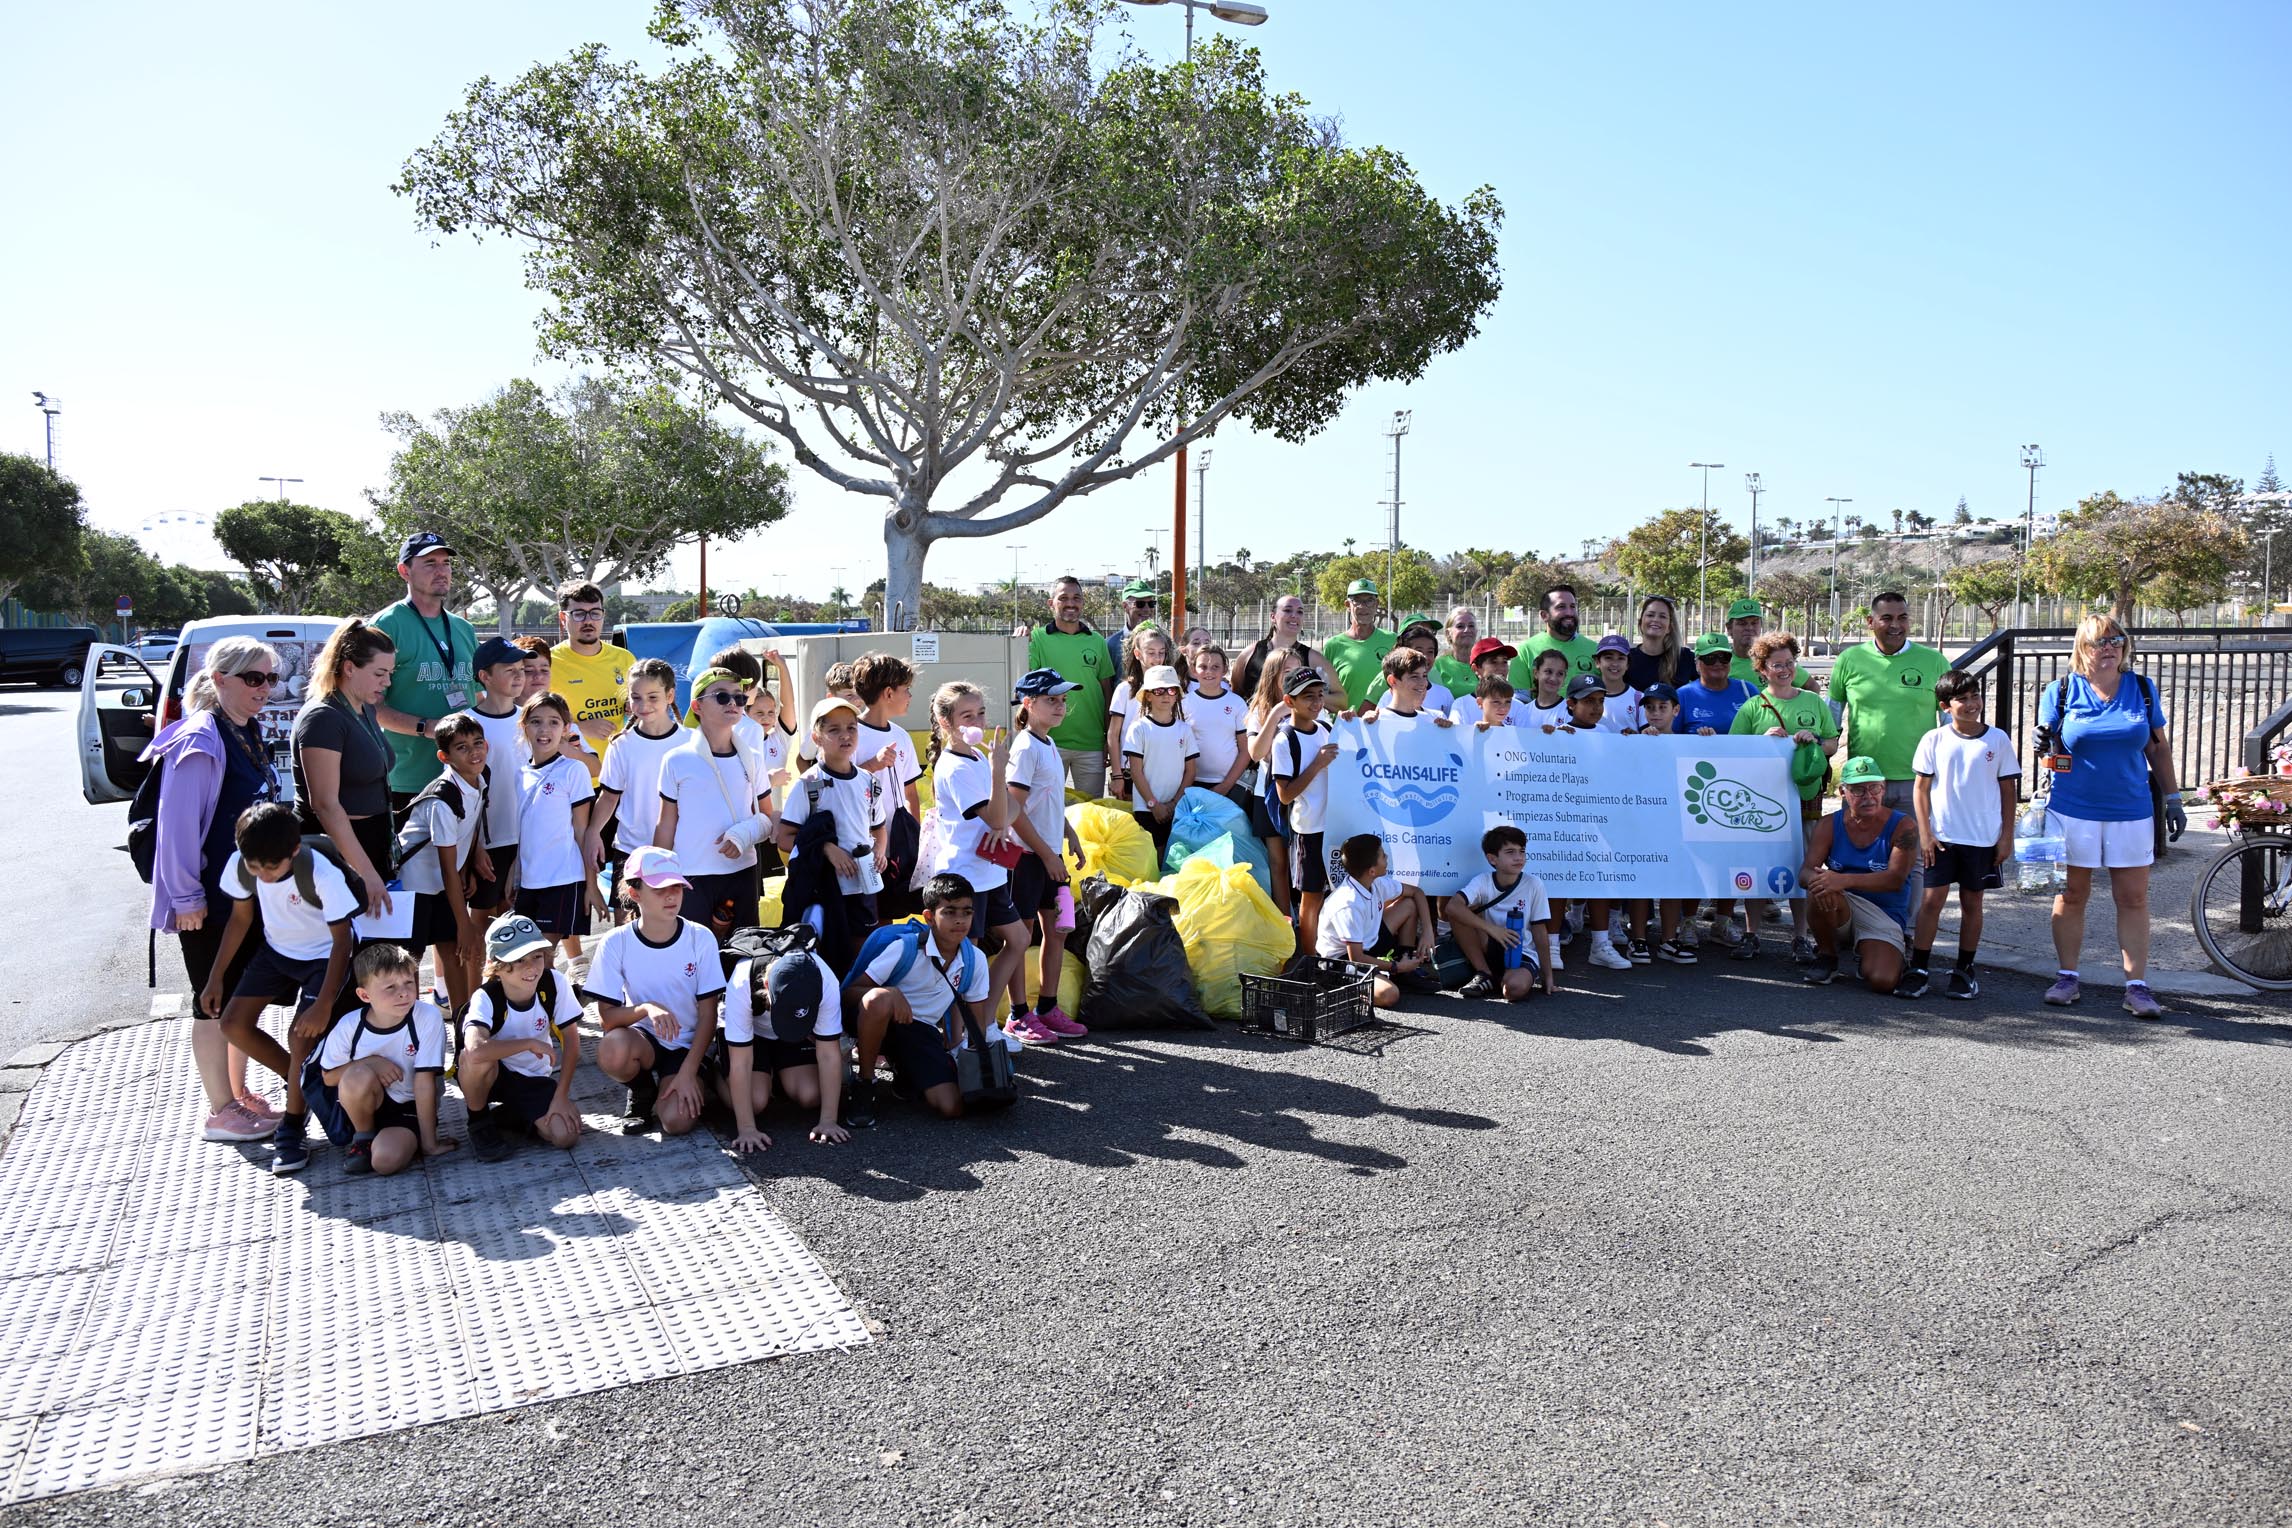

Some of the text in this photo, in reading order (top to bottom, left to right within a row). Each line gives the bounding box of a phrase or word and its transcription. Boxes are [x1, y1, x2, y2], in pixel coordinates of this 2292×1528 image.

[585, 697, 617, 709] Gran
[1504, 750, 1577, 764] ONG Voluntaria
[1361, 763, 1458, 782] OCEANS4LIFE
[1505, 770, 1589, 787] Limpieza de Playas
[1506, 790, 1668, 806] Programa de Seguimiento de Basura
[1506, 810, 1609, 824] Limpiezas Submarinas
[1401, 831, 1453, 846] Canarias
[1553, 830, 1599, 843] Educativo
[1585, 850, 1613, 863] Social
[1614, 851, 1669, 865] Corporativa
[1565, 870, 1578, 882] de
[1579, 870, 1596, 882] Eco
[1596, 871, 1637, 882] Turismo
